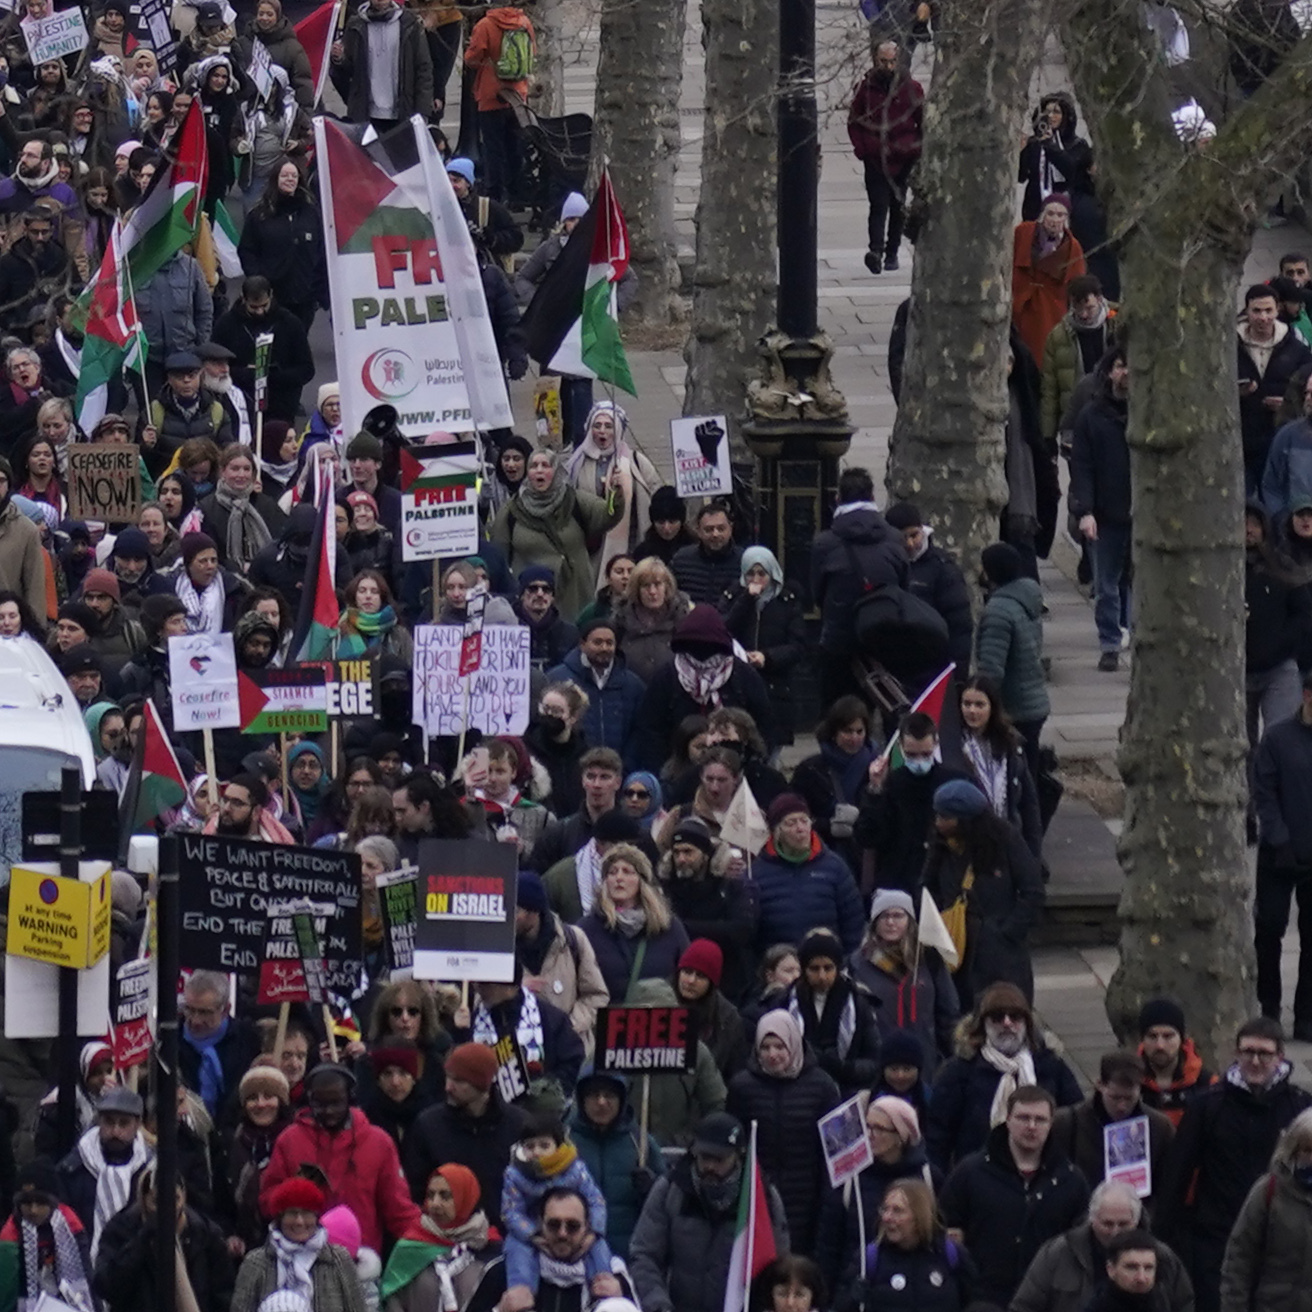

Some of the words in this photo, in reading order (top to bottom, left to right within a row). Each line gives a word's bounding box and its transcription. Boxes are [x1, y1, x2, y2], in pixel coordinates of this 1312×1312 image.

[27, 14, 82, 43] PALESTINE
[34, 34, 83, 59] HUMANITY
[71, 453, 133, 471] CEASEFIRE
[77, 475, 137, 511] NOW!
[413, 485, 467, 508] FREE
[405, 504, 475, 523] PALESTINE
[498, 629, 530, 648] HAVE
[338, 661, 372, 683] THE
[502, 674, 526, 696] YOU
[179, 689, 230, 705] Ceasefire
[266, 712, 321, 728] GENOCIDE
[184, 838, 219, 862] WE
[225, 845, 270, 869] WANT
[205, 867, 253, 888] PEACE
[427, 874, 504, 895] SANCTIONS
[210, 889, 247, 908] BUT
[426, 892, 449, 913] ON
[452, 893, 506, 916] ISRAEL
[18, 914, 78, 940] WARNING
[182, 911, 224, 934] END
[229, 918, 266, 936] THE
[30, 933, 64, 950] Parking
[219, 943, 258, 967] END
[606, 1008, 689, 1049] FREE
[604, 1047, 686, 1069] PALESTINE
